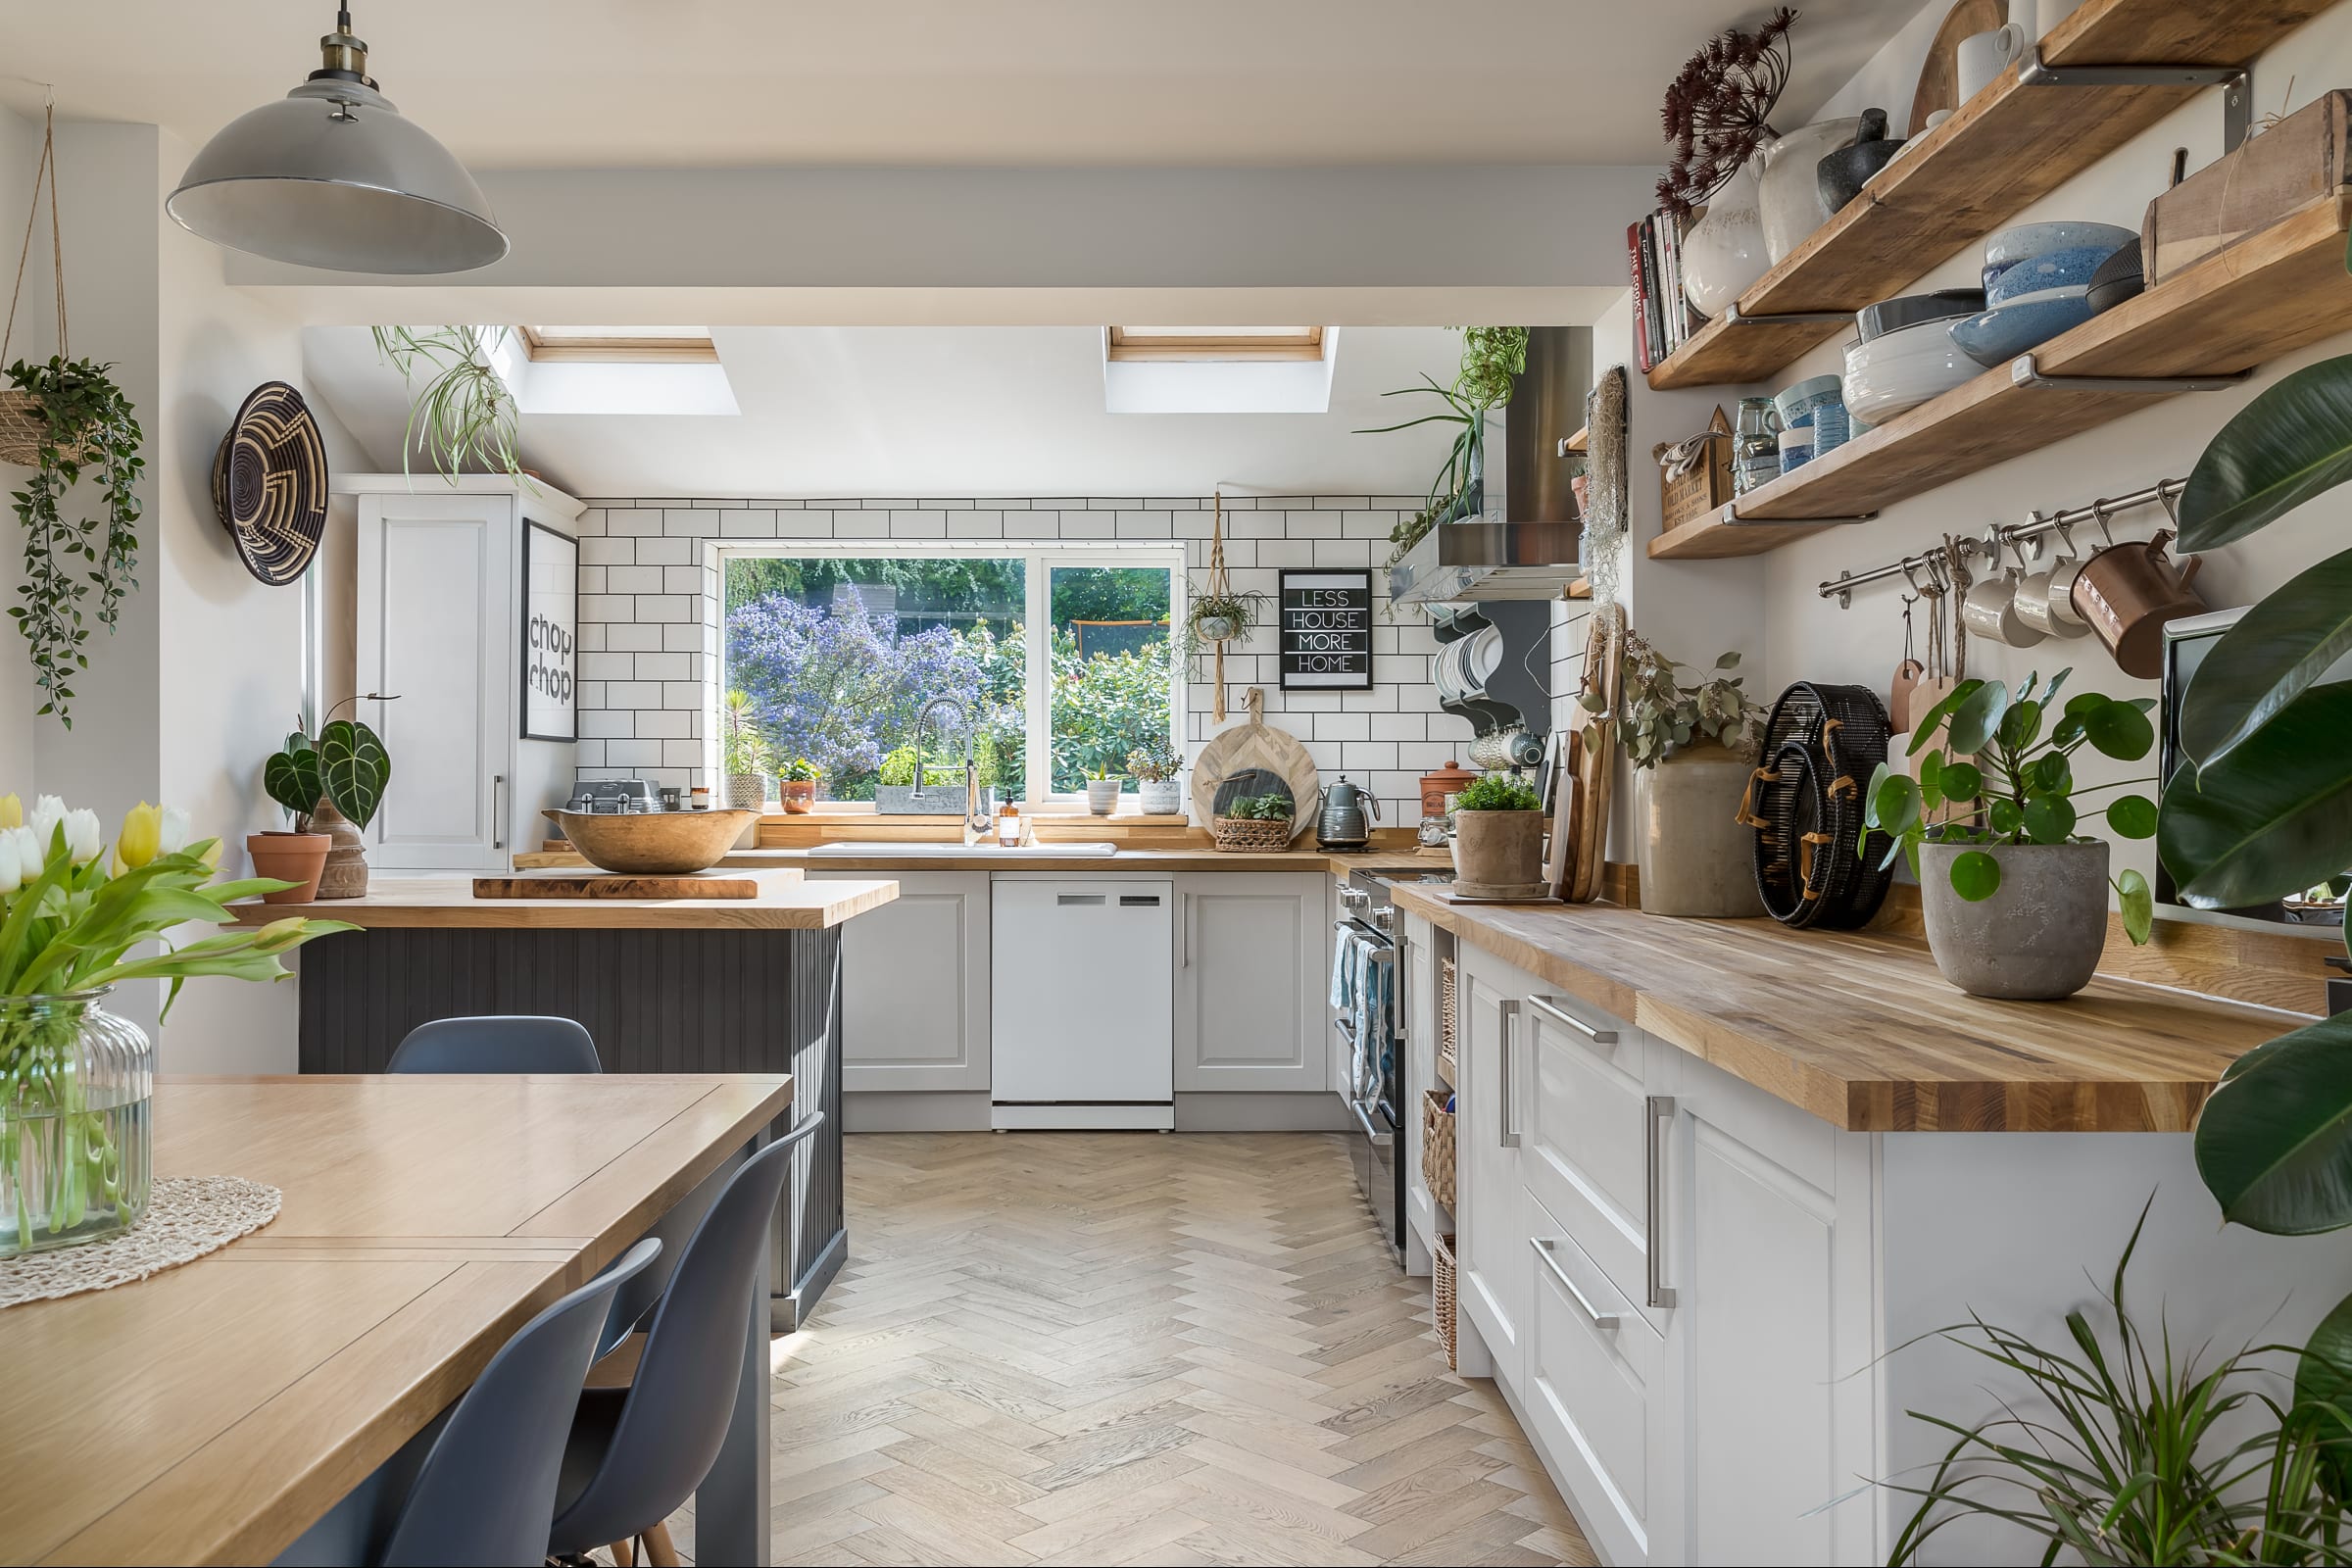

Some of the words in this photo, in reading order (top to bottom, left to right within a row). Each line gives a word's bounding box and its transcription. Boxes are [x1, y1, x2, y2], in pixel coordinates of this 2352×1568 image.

[1633, 274, 1642, 320] COOK'S
[1680, 477, 1702, 503] MARKET
[1301, 590, 1349, 607] LESS
[1293, 612, 1359, 628] HOUSE
[530, 612, 572, 665] chop
[1298, 633, 1352, 651] MORE
[1298, 655, 1353, 672] HOME
[529, 652, 571, 706] chop
